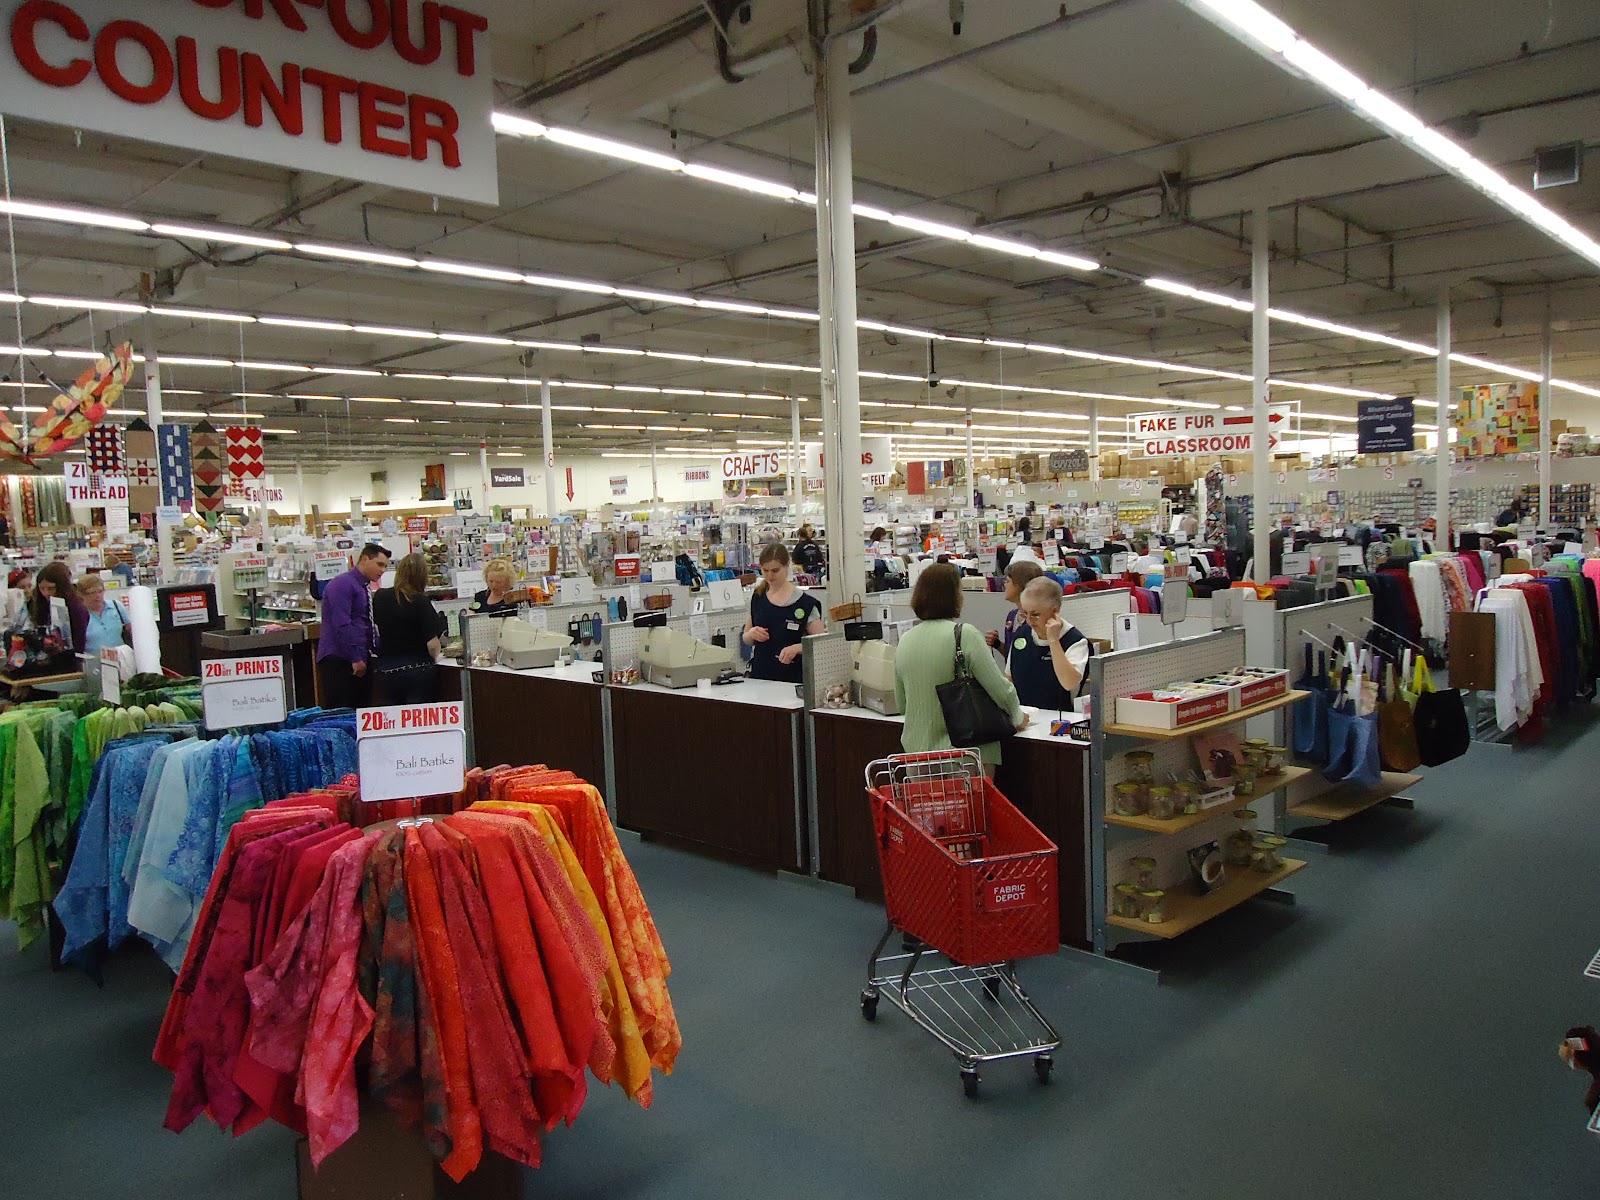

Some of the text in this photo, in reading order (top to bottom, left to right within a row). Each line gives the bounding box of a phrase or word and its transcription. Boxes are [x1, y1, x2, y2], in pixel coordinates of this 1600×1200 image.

[11, 0, 462, 168] COUNTER
[1140, 415, 1215, 432] FAKE FUR
[1146, 435, 1251, 456] CLASSROOM
[723, 452, 779, 478] CRAFTS
[685, 471, 710, 481] RIBBONS
[870, 474, 886, 486] FELT
[69, 486, 126, 499] THREAD
[723, 589, 731, 601] 6
[235, 660, 280, 676] PRINTS
[383, 719, 396, 730] off
[401, 705, 460, 728] PRINTS
[396, 753, 455, 770] Bali Batiks
[993, 884, 1026, 895] FABRIC
[995, 892, 1026, 903] DEPOT
